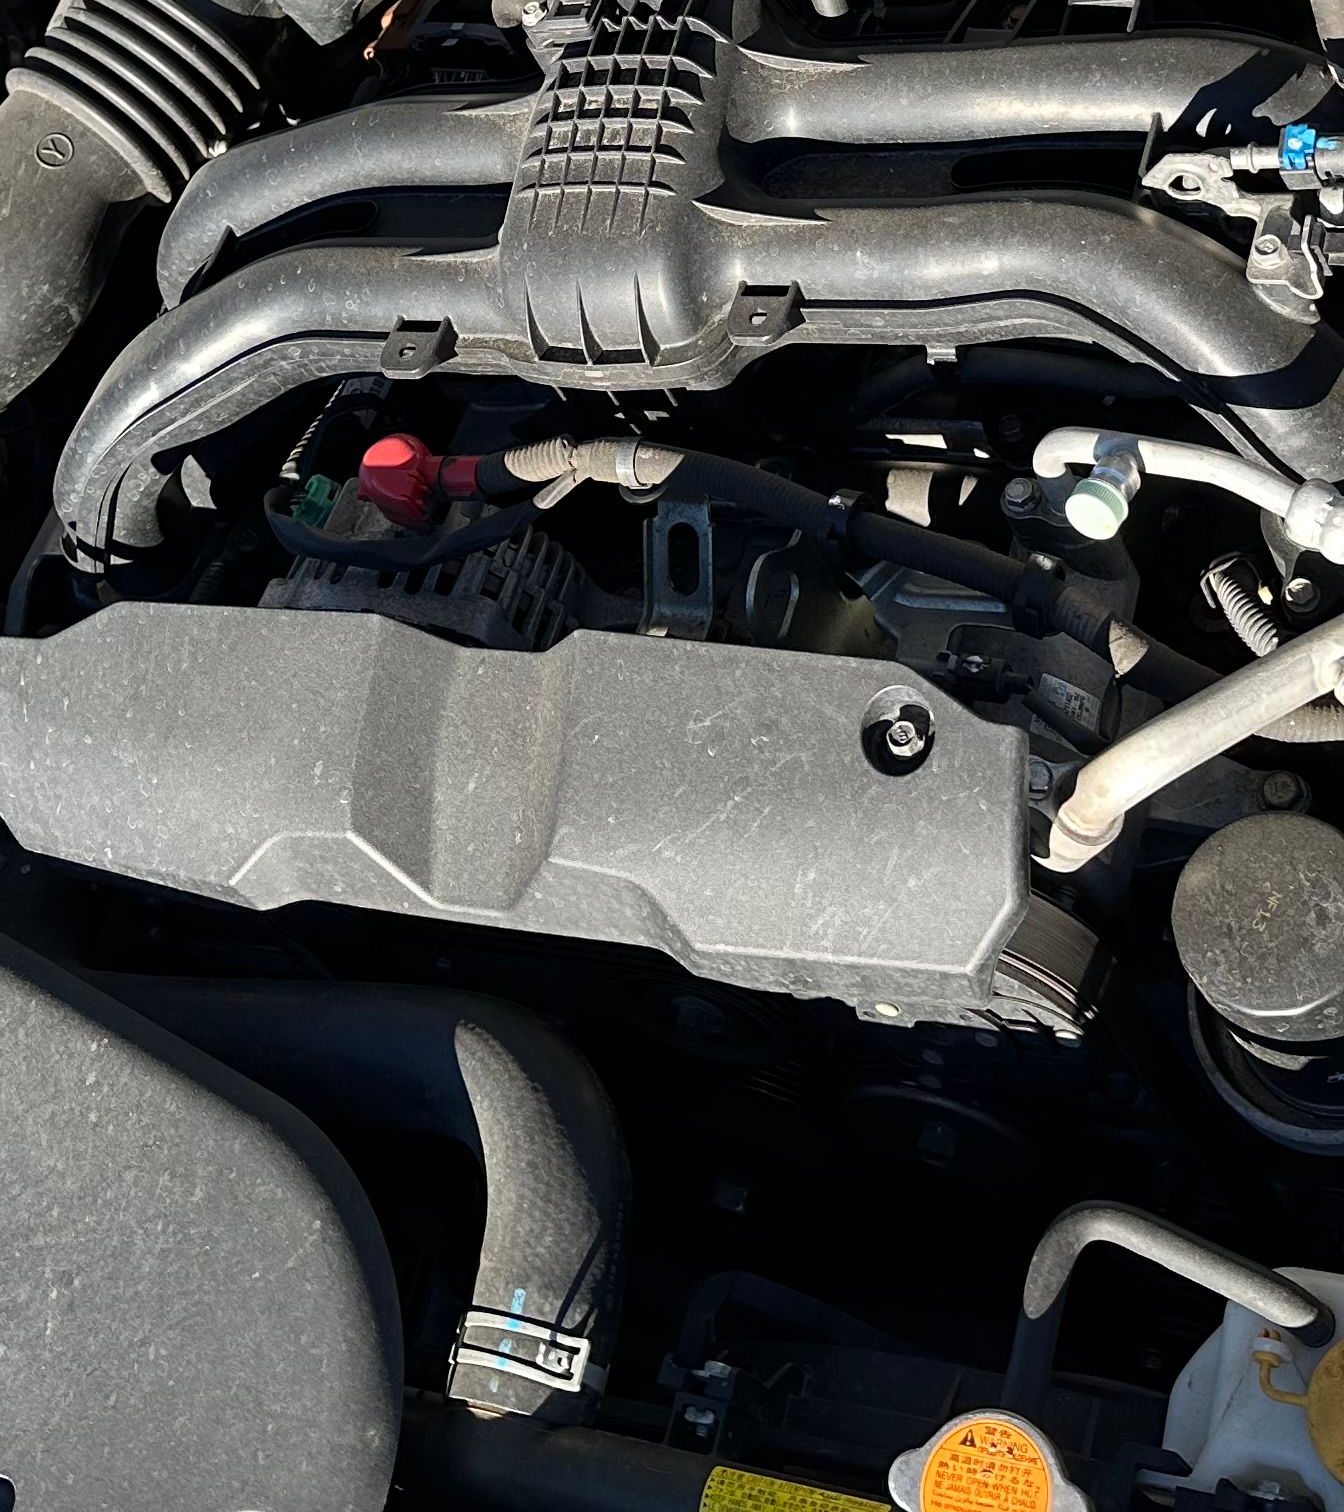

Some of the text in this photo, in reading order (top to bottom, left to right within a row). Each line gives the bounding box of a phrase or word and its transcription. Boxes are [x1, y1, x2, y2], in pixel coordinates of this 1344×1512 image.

[979, 1434, 1029, 1454] WARNING
[933, 1479, 945, 1490] NE
[934, 1470, 964, 1484] NEVER
[966, 1474, 990, 1489] OPEN
[991, 1479, 1018, 1495] WHEN
